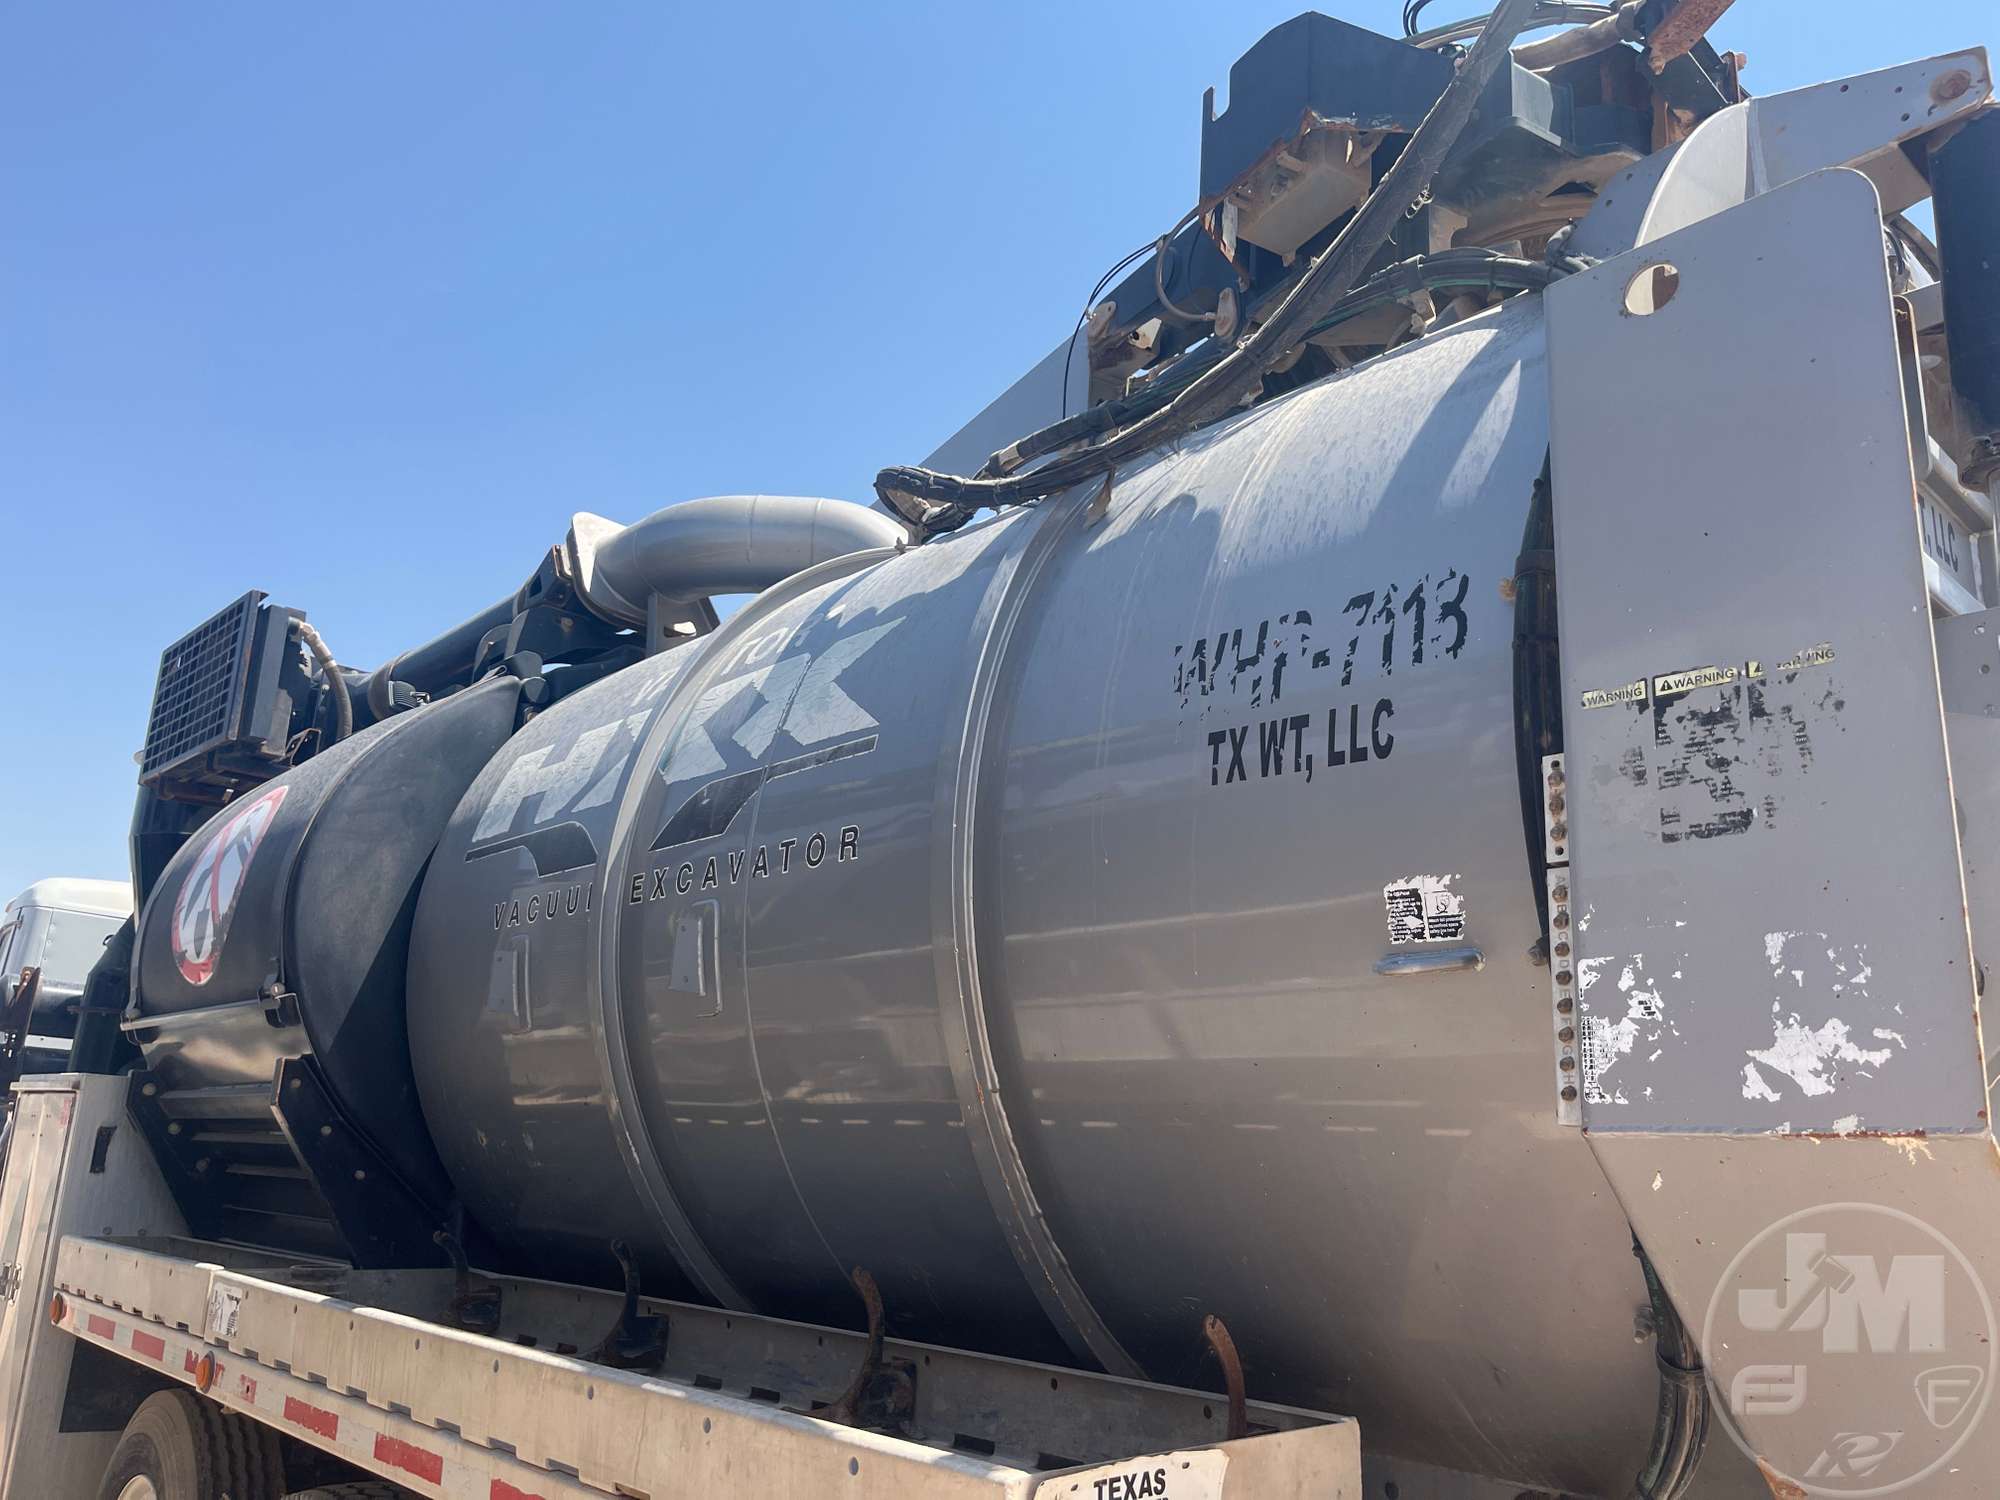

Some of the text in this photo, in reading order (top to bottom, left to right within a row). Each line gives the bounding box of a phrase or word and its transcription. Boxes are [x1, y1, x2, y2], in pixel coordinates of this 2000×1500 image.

[1673, 668, 1735, 690] WARNING
[1586, 686, 1643, 706] WARNING
[1207, 697, 1395, 786] TX WT, LLC
[629, 824, 861, 905] EXCAVATOR
[1093, 1468, 1166, 1500] TEXAS
